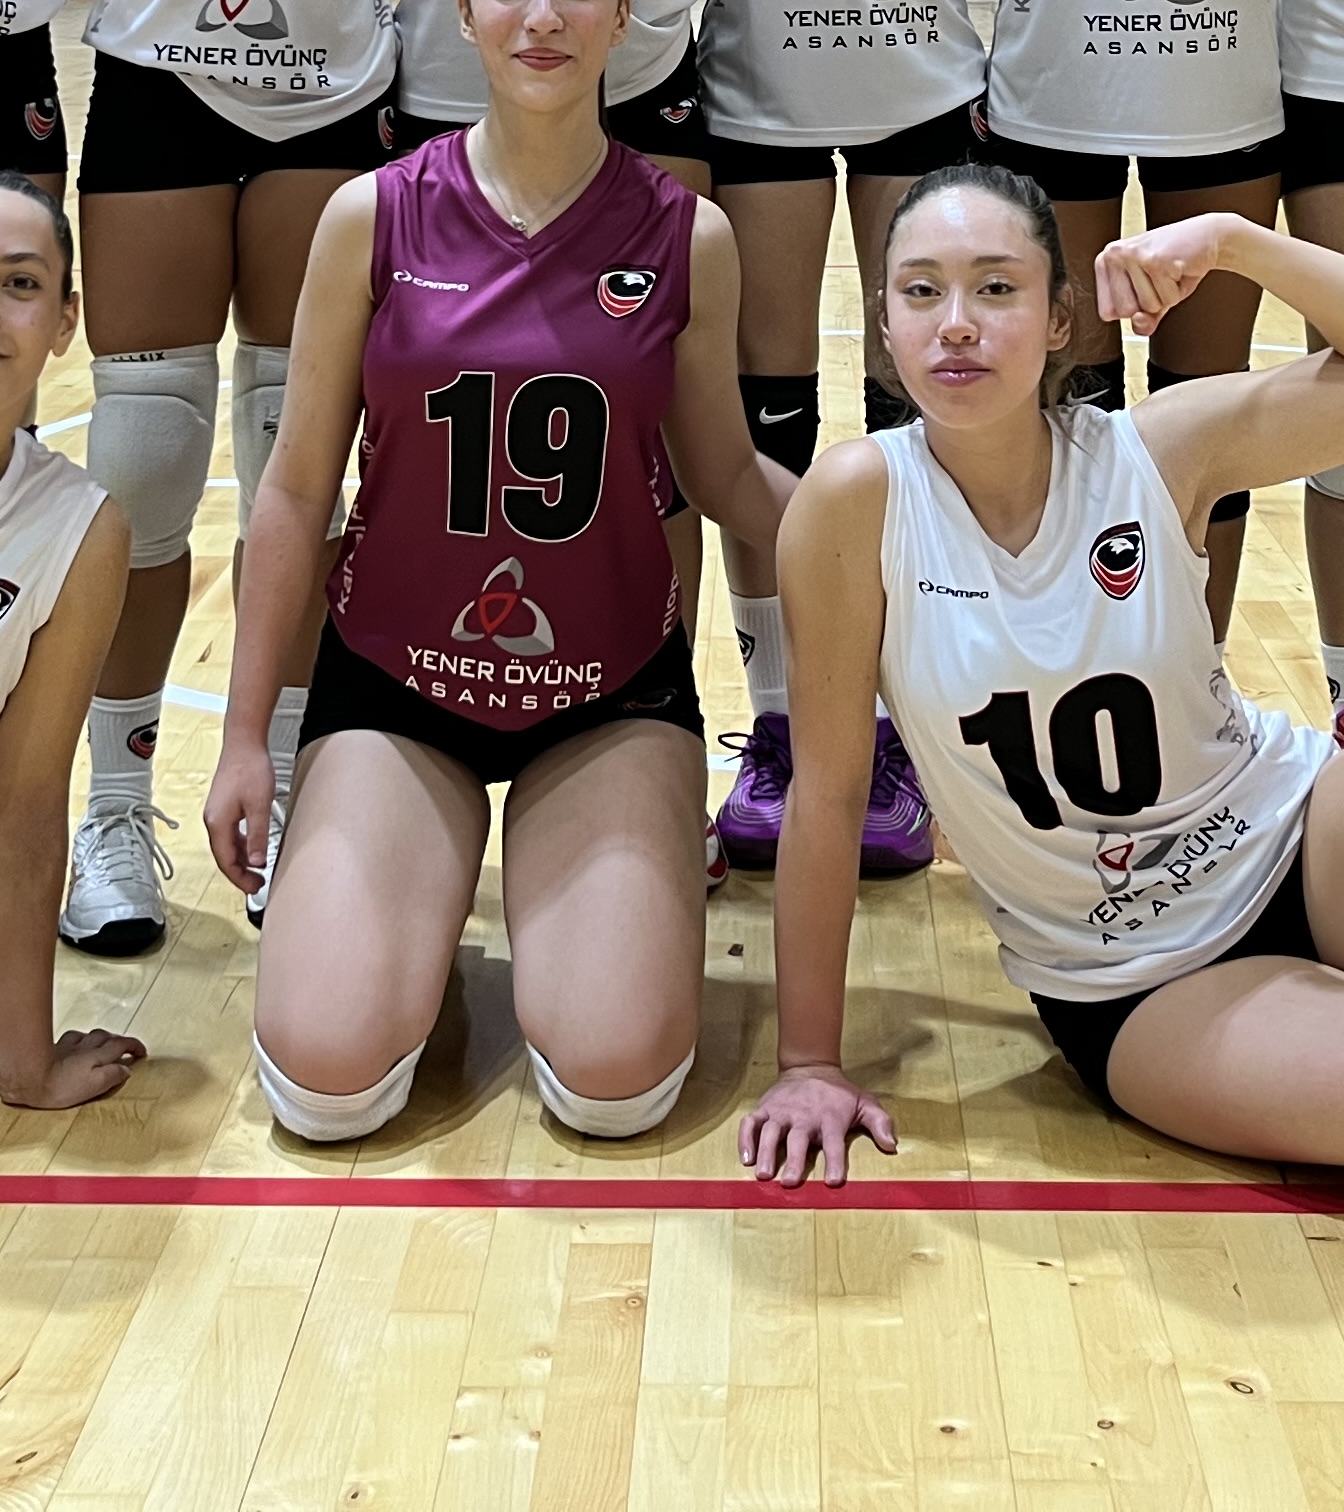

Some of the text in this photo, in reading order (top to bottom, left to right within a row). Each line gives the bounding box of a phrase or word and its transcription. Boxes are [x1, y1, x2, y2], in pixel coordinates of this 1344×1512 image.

[783, 2, 938, 28] YENER ÖVÜNÇ
[1083, 7, 1238, 33] YENER ÖVÜNÇ
[782, 28, 940, 50] ASANSÖR
[1083, 34, 1237, 55] ASANSÖR
[153, 43, 327, 72] YENER ÖVÜNÇ
[424, 370, 610, 543] 19
[406, 644, 602, 691] YENER ÖVÜNÇ
[957, 672, 1164, 831] 10
